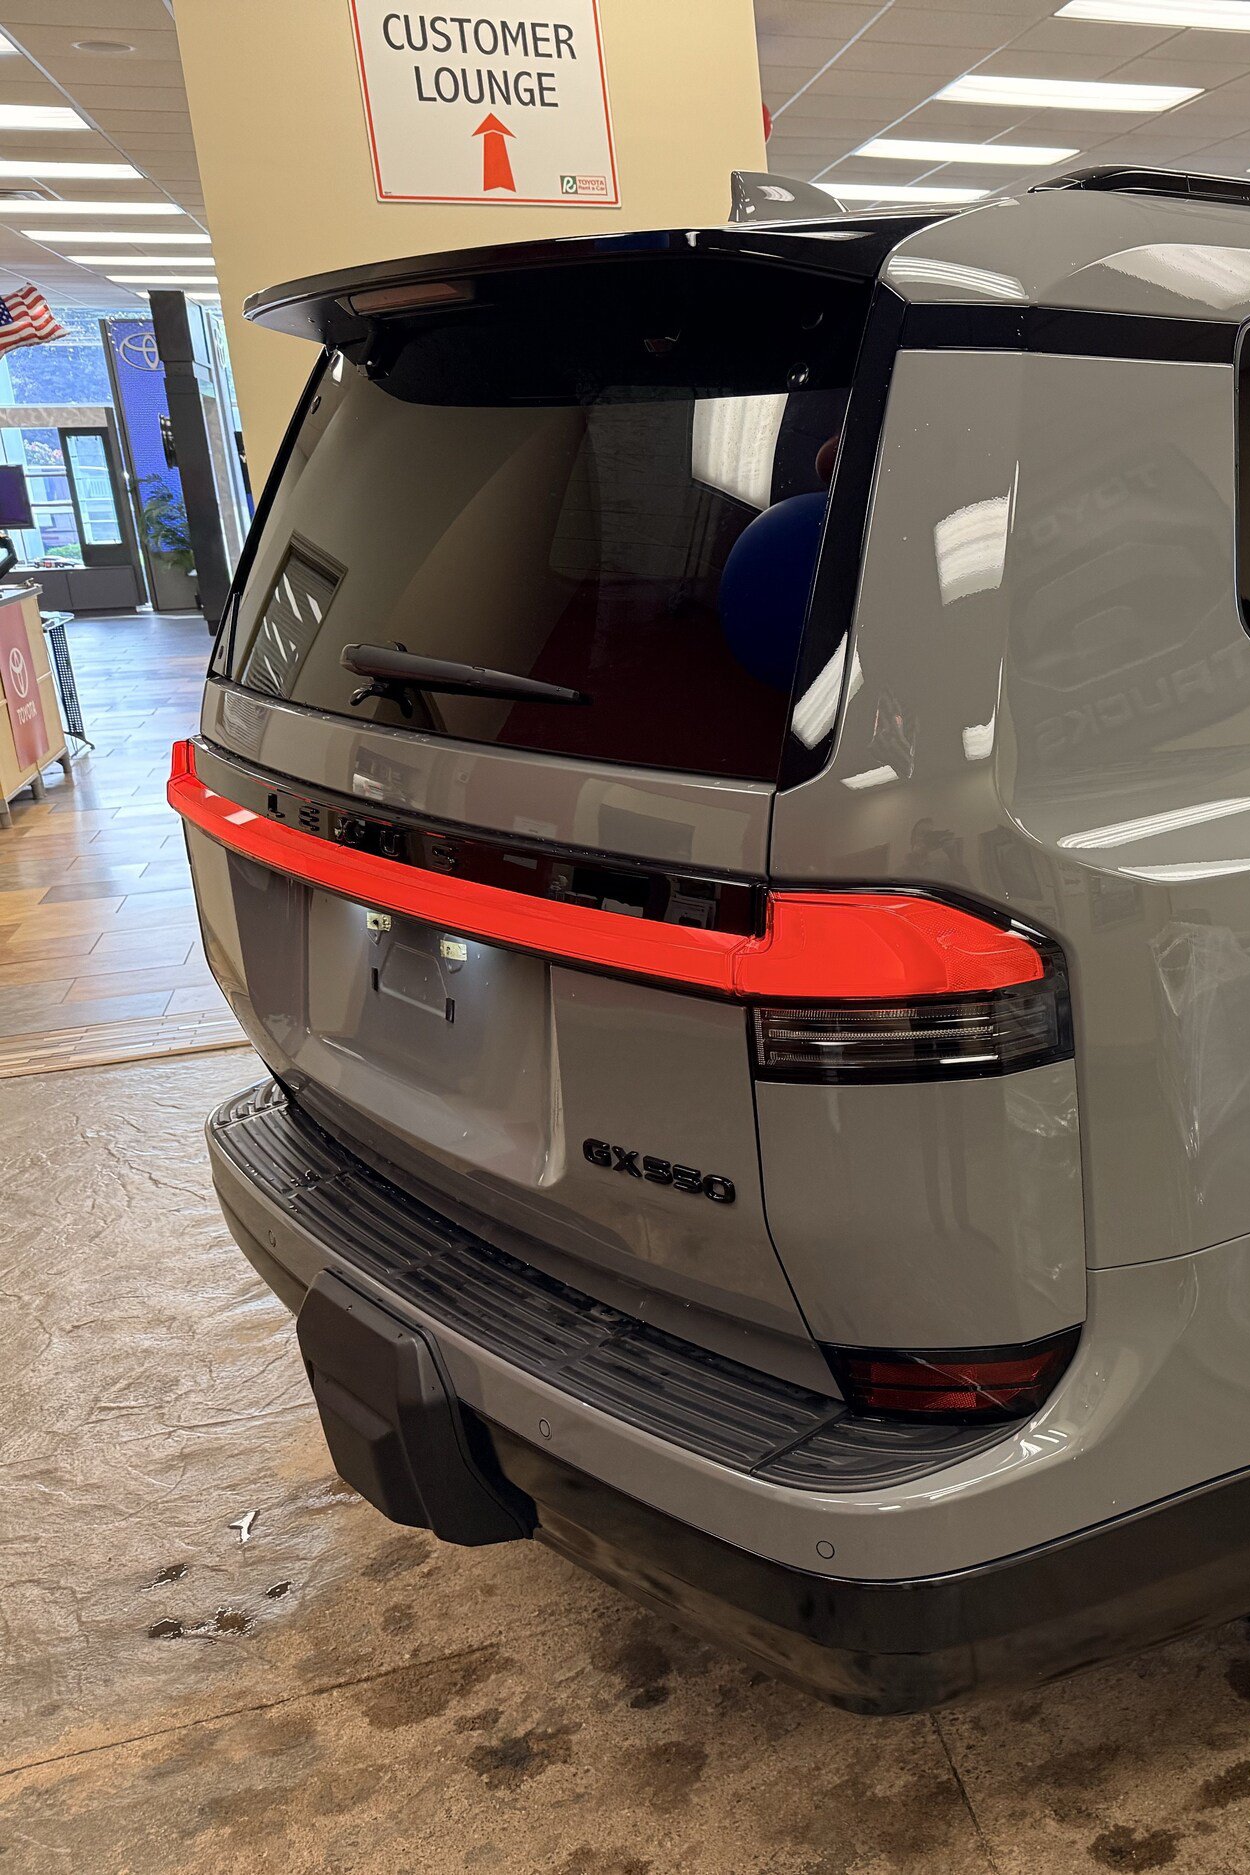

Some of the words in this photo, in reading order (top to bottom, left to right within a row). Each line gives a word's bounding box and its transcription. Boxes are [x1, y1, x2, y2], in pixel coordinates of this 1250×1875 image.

[382, 13, 577, 60] CUSTOMER
[413, 65, 559, 108] LOUNGE
[16, 700, 37, 725] TOYOTA
[266, 792, 459, 873] LEXUS
[582, 1138, 736, 1204] GX550
